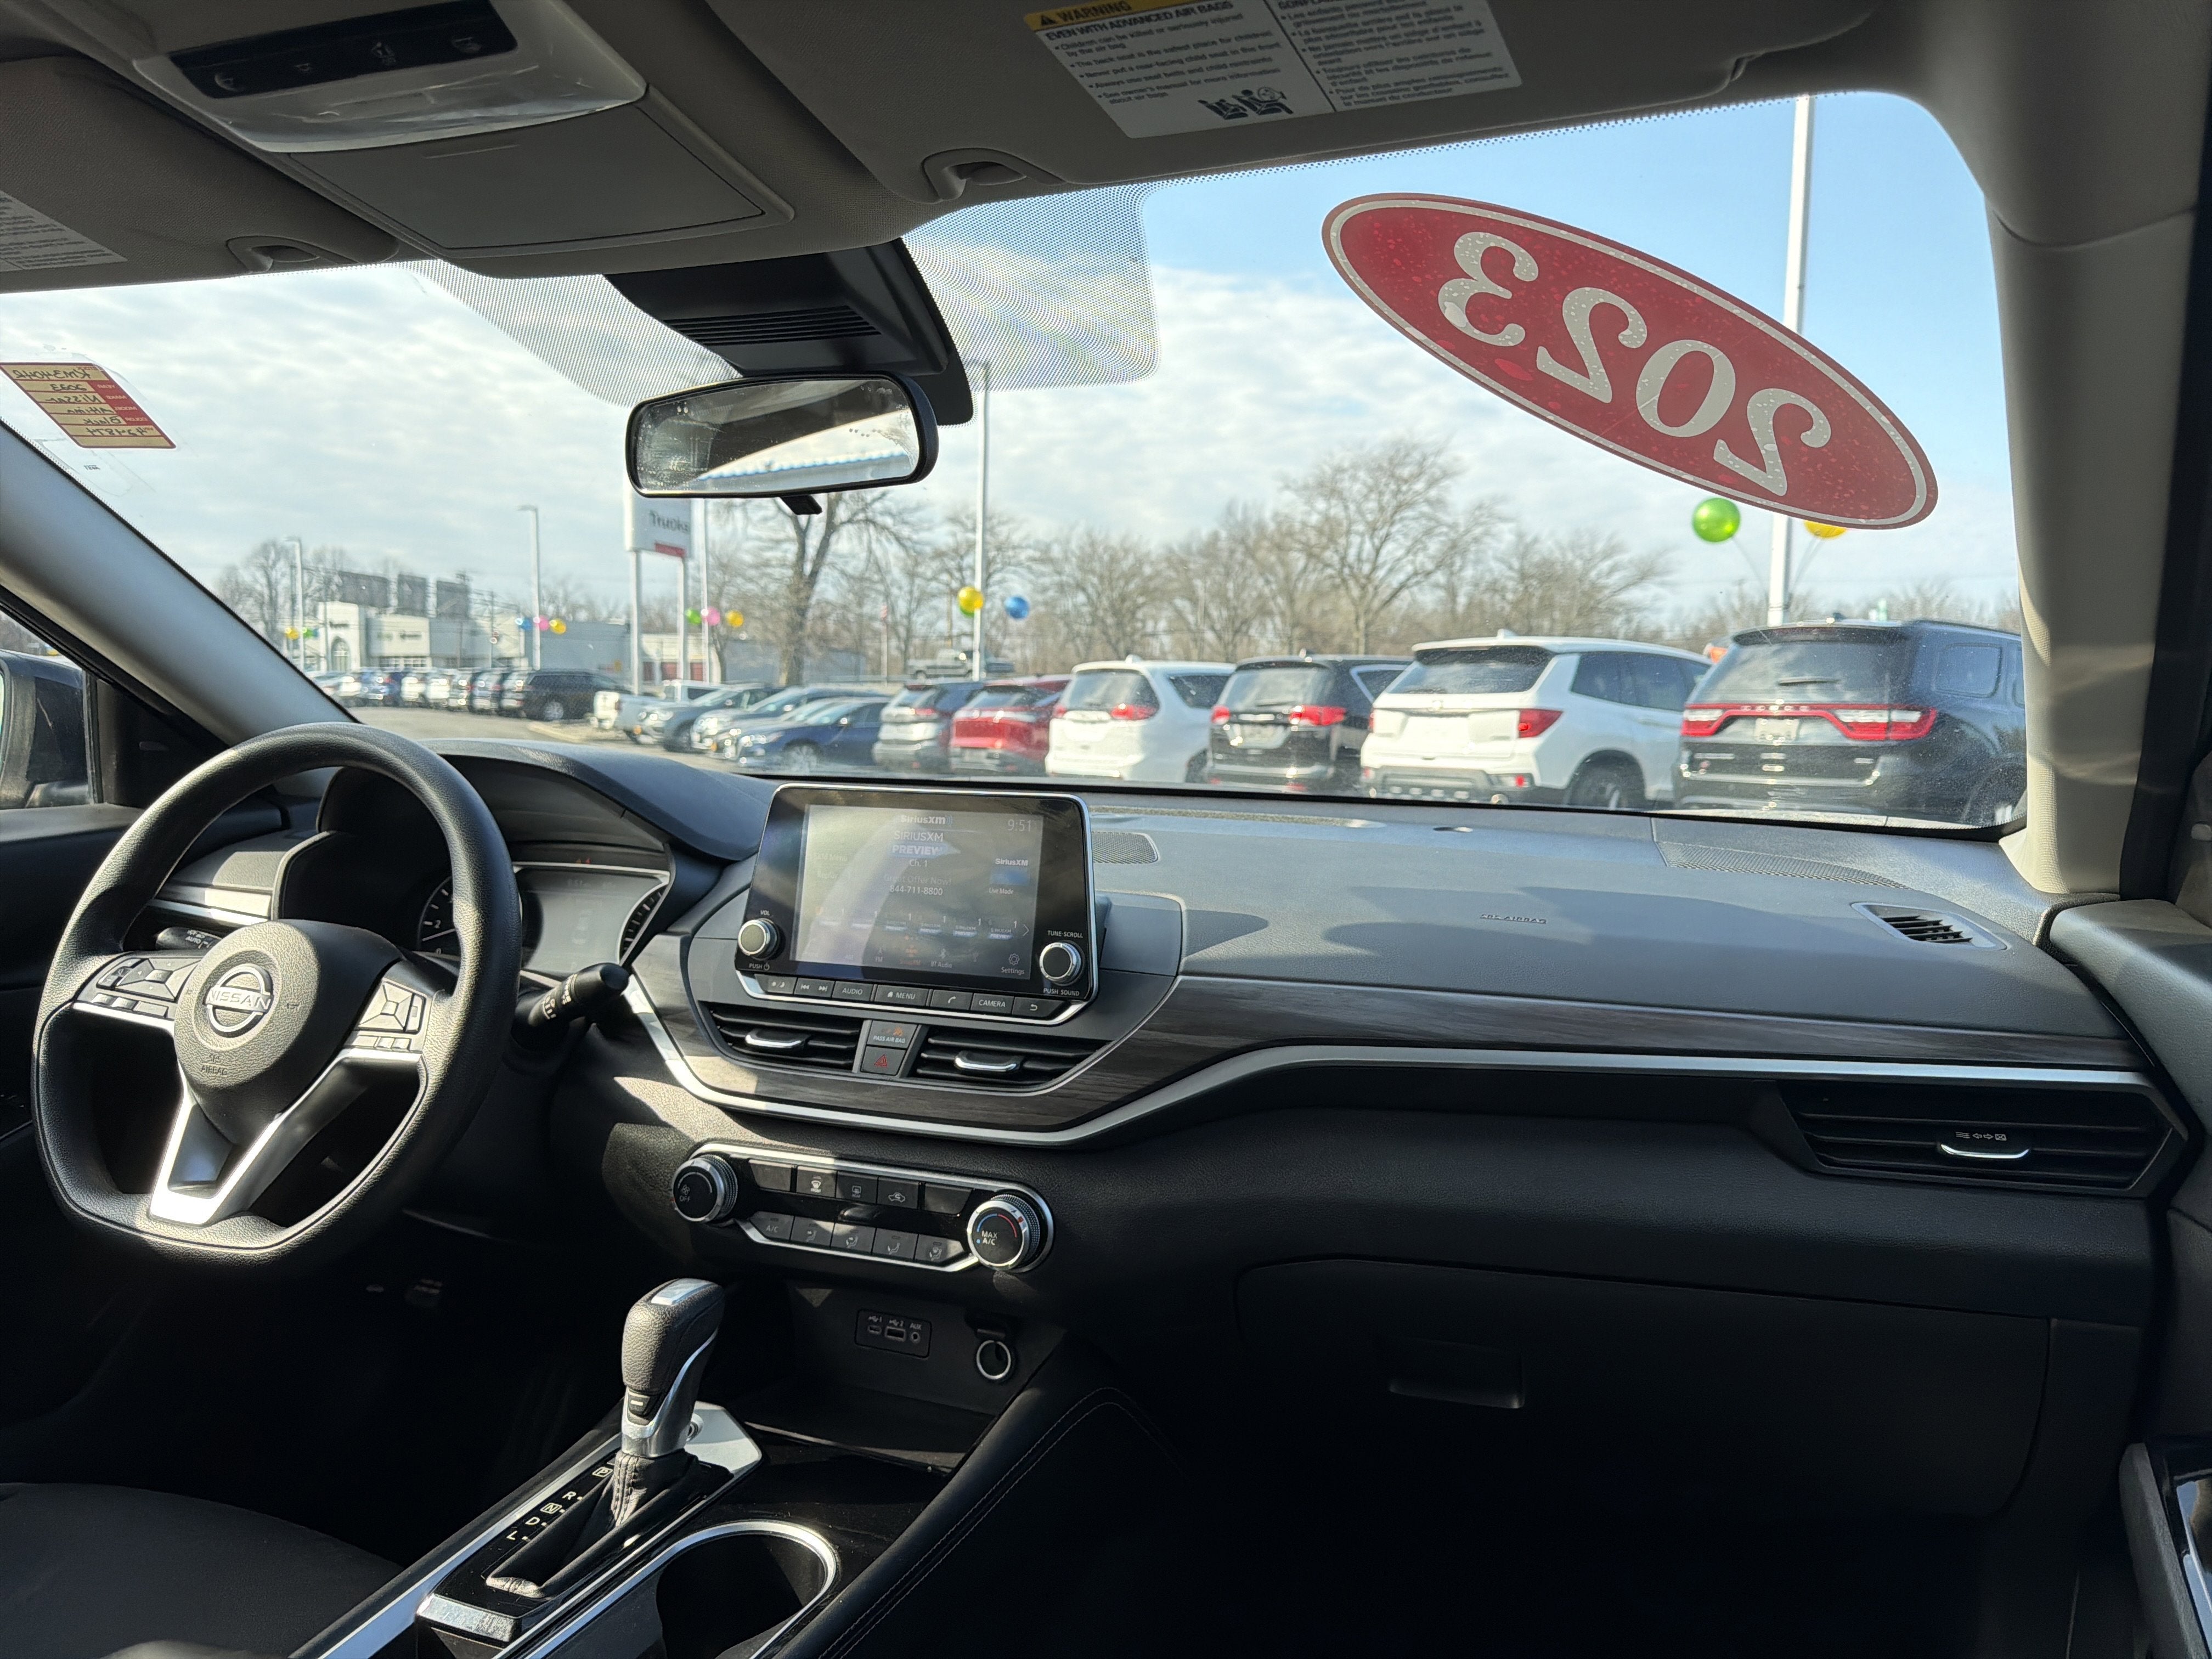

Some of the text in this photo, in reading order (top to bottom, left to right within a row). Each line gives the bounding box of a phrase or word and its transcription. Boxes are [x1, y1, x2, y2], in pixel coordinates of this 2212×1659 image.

[1057, 1, 1132, 22] WARNING
[1046, 30, 1077, 41] EVEN
[1077, 22, 1109, 34] WITH
[1109, 12, 1173, 30] ADVANCED
[1007, 819, 1032, 832] 9:51
[893, 830, 944, 842] SIRIUSXM
[891, 845, 943, 856] PREVIEW
[889, 884, 944, 895] 844-711-8800
[185, 935, 201, 944] AUTO
[1001, 967, 1025, 975] Settings
[208, 990, 272, 1010] NISSAN
[895, 991, 916, 1000] MENU
[978, 999, 1006, 1008] CAMERA
[981, 1230, 998, 1239] MAX
[982, 1237, 996, 1246] A/C
[562, 1491, 577, 1500] R
[525, 1516, 540, 1525] D
[506, 1530, 518, 1541] L
